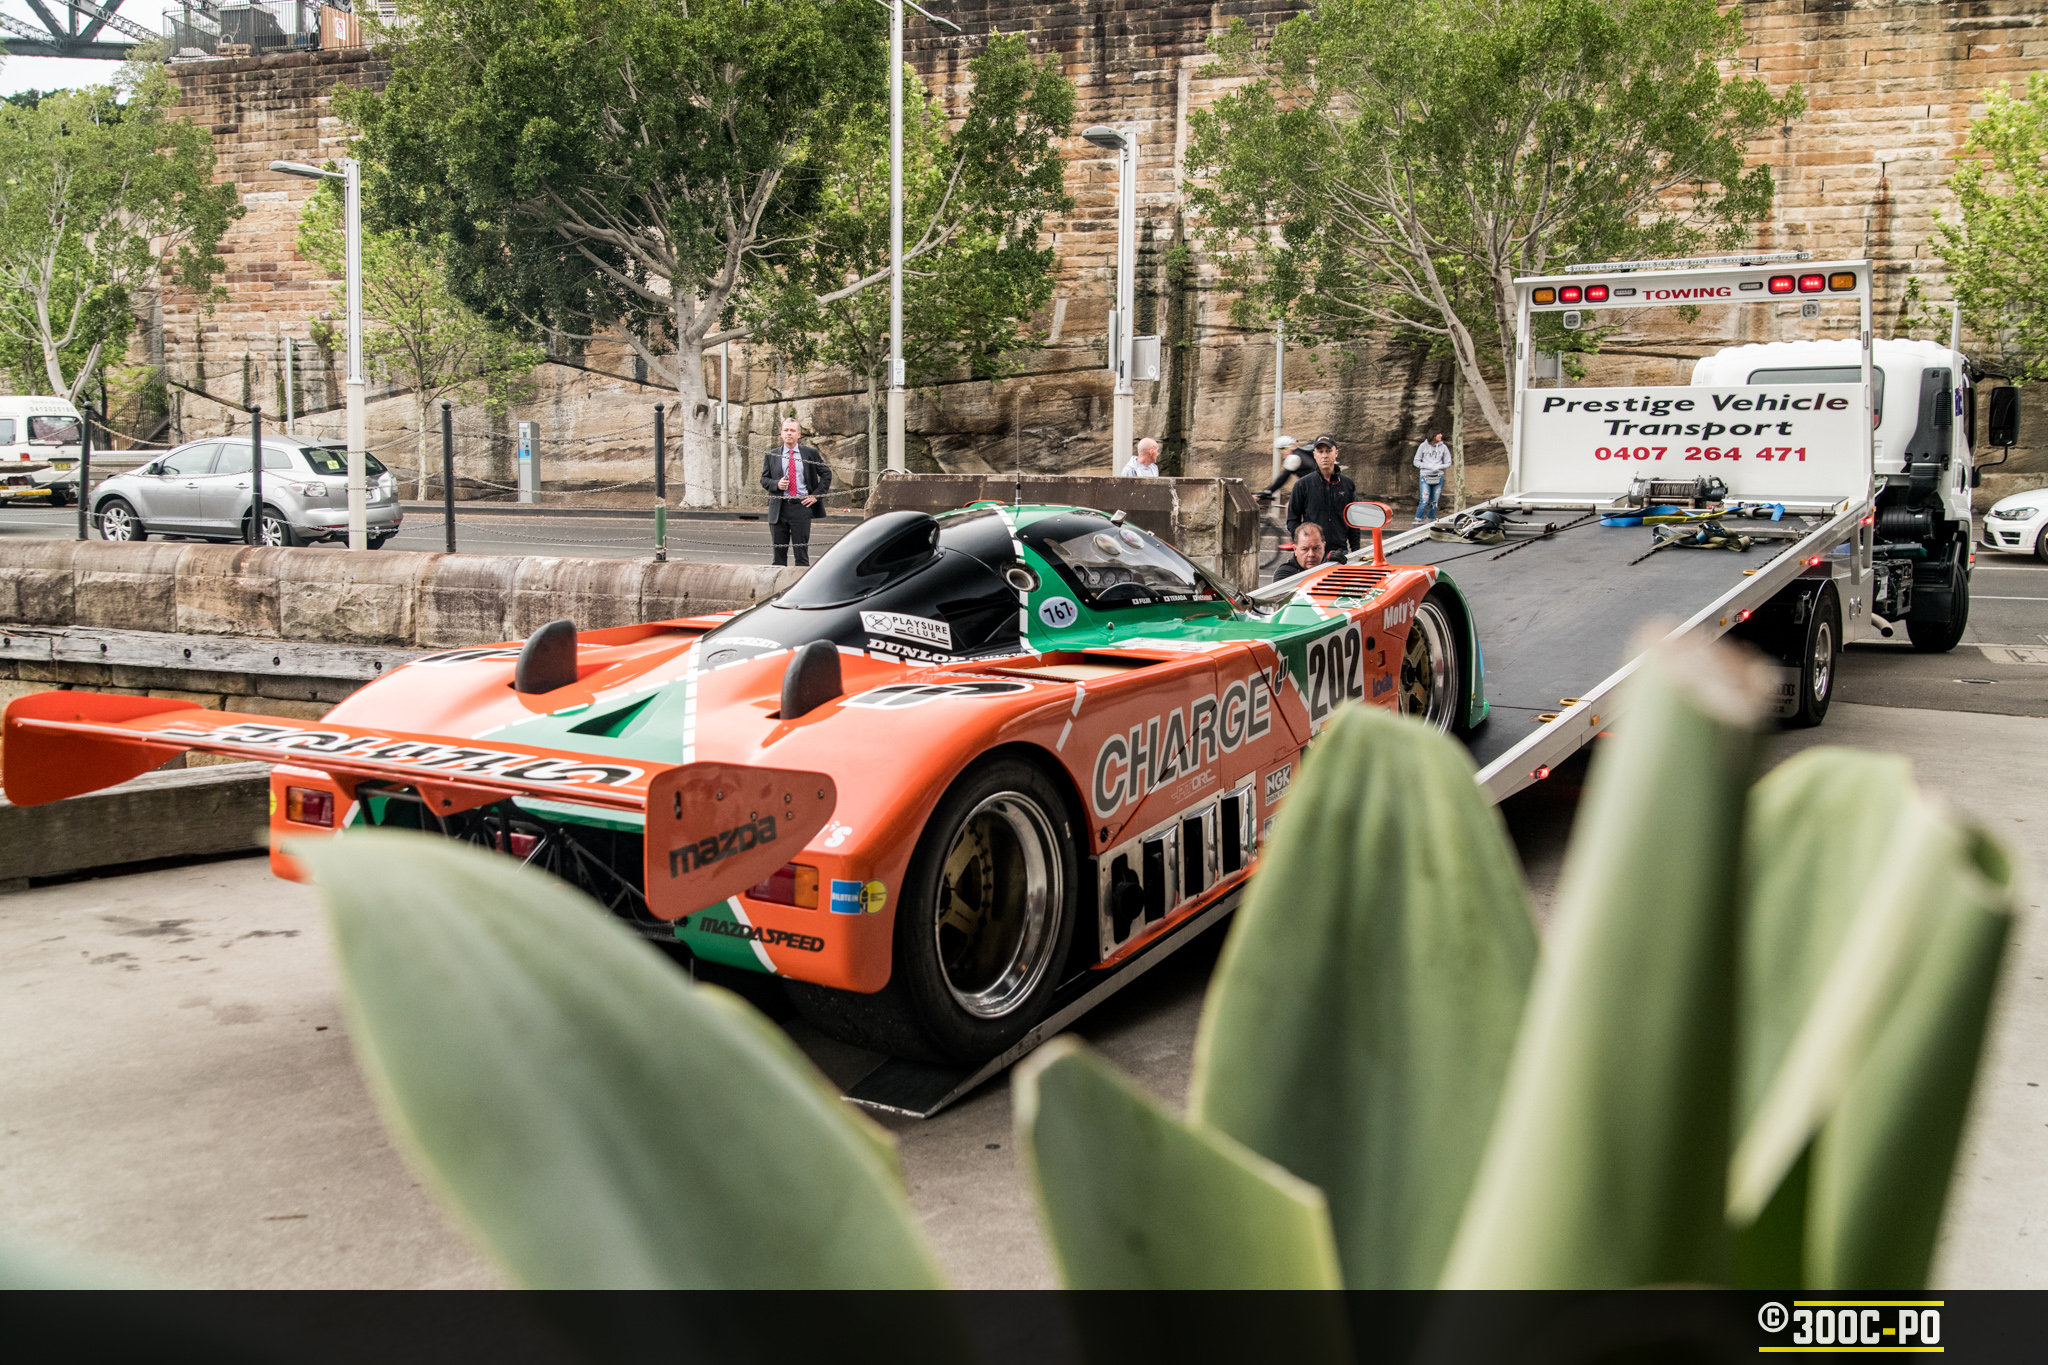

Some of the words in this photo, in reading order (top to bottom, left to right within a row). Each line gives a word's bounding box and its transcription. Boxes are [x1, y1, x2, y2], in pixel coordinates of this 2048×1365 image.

[1642, 286, 1732, 300] TOWING
[1542, 395, 1695, 416] Prestige
[1712, 392, 1849, 411] Vehicle
[1604, 419, 1793, 440] Transport
[1594, 446, 1668, 461] 0407
[1684, 446, 1742, 461] 264
[1755, 446, 1807, 461] 471
[892, 616, 948, 635] PLAYSURE
[1383, 598, 1415, 630] Moty's
[907, 626, 937, 639] CLUB
[867, 638, 966, 663] DUNLOP
[1309, 627, 1362, 723] 202
[1092, 666, 1272, 819] CHARGE
[1266, 764, 1290, 796] NGK
[669, 815, 777, 879] mazda
[831, 891, 859, 903] BILSTEIN
[700, 916, 826, 953] MAZDASPEED
